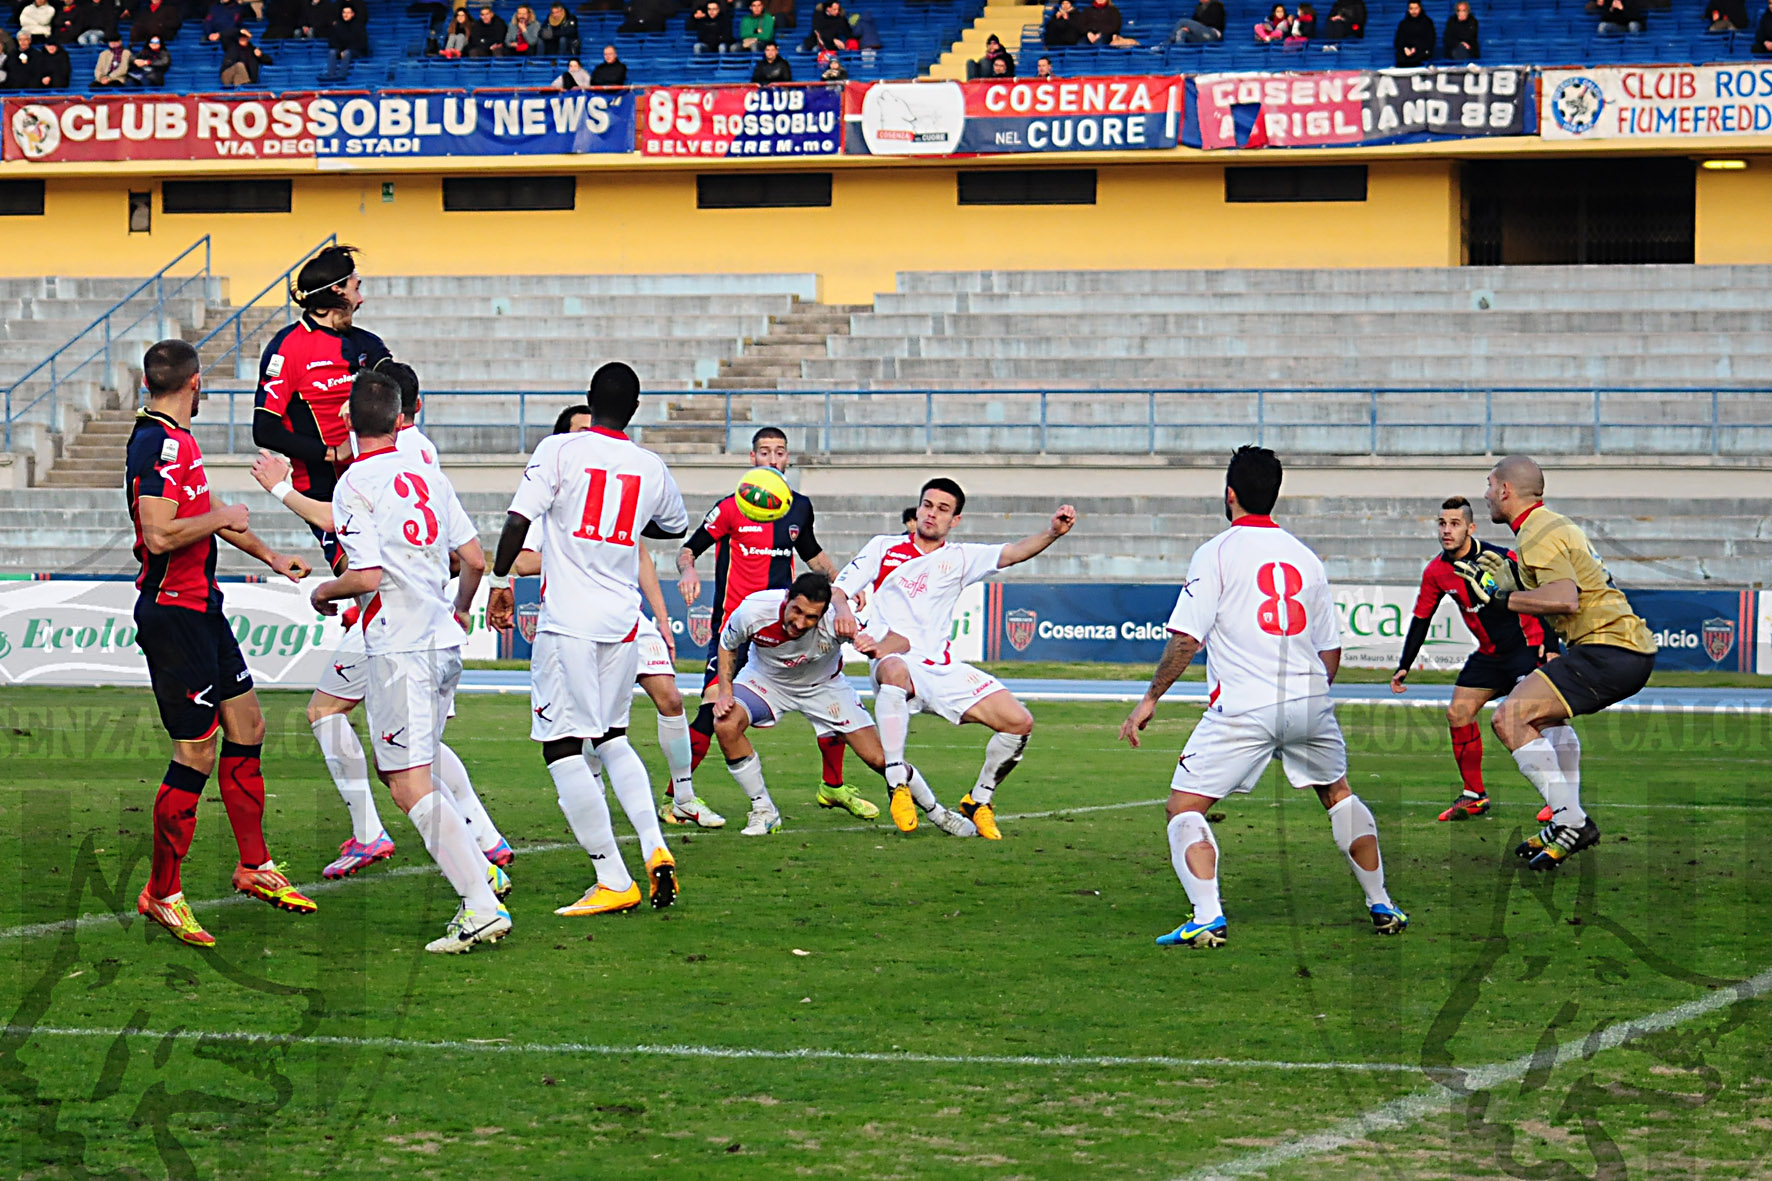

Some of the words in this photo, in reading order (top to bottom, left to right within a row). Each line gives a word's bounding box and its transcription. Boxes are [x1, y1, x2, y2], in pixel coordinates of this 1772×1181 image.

[985, 83, 1152, 112] COSENZA
[1211, 75, 1399, 108] COSENZA
[1621, 71, 1697, 100] CLUB
[744, 91, 805, 112] CLUB
[1461, 101, 1515, 128] 88
[60, 102, 188, 142] CLUB
[197, 97, 477, 140] ROSSOBLU
[712, 112, 836, 137] ROSSOBLU
[995, 131, 1021, 145] NEL
[1027, 116, 1146, 148] CUORE
[1617, 103, 1772, 134] FIUMEFREDD
[215, 140, 256, 156] VIA
[263, 138, 338, 155] DEGLI
[345, 137, 420, 154] STADI
[646, 139, 771, 155] BELVEDERE
[393, 471, 438, 546] 3
[573, 467, 642, 546] 11
[1256, 561, 1307, 636] 8
[1038, 620, 1117, 640] Cosenza
[1120, 620, 1173, 640] Calci
[1651, 629, 1699, 648] alcio
[1343, 651, 1358, 661] San
[1359, 651, 1385, 661] Mauro
